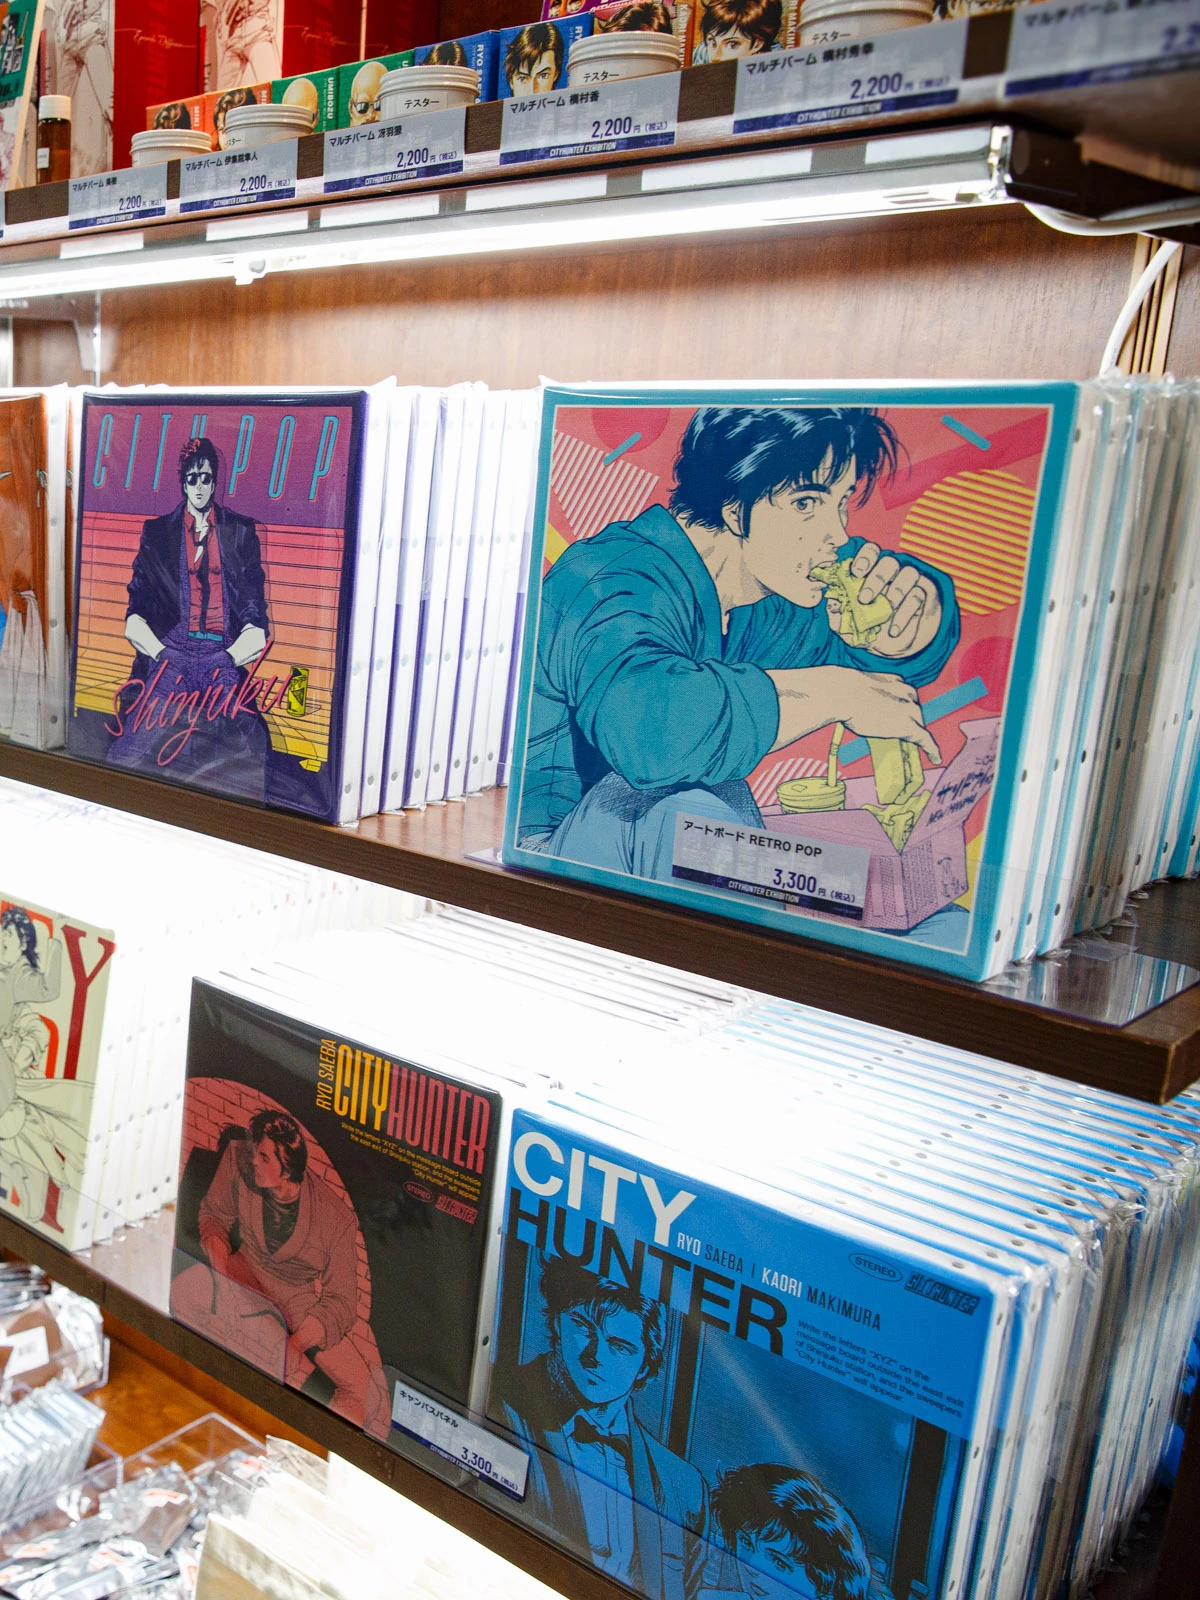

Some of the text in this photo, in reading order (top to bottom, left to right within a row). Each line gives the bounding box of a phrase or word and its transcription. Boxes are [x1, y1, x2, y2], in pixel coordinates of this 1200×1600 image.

[678, 3, 688, 32] KAORI
[786, 12, 796, 49] MAKIMU
[811, 31, 852, 43] テスター
[476, 44, 484, 66] RYO
[746, 53, 817, 75] マルチバーム
[583, 73, 619, 83] テスター
[326, 77, 335, 120] UMIBOZU
[404, 98, 440, 108] テスター
[509, 98, 566, 113] マルチバーム
[328, 131, 376, 148] マルチバーム
[185, 158, 222, 171] マルチバーム
[72, 180, 104, 192] マルチバーム
[228, 414, 340, 502] POP
[103, 639, 294, 767] Shinjuku
[683, 820, 823, 858] アートボード RETRO POP
[728, 880, 800, 904] CITYHUNTER EXHIBITION
[315, 1038, 337, 1111] RYO SAEBA
[512, 1131, 697, 1249] CITY
[508, 1187, 789, 1360] HUNTER
[677, 1232, 881, 1332] RYO SAEBA KAORI MAKIMURA
[855, 1256, 897, 1279] STEREO
[798, 1319, 820, 1335] Write
[822, 1330, 837, 1342] the
[838, 1336, 867, 1355] letters
[899, 1363, 912, 1373] on
[914, 1368, 930, 1382] the
[795, 1339, 805, 1348] of
[805, 1342, 843, 1367] Shinjuku
[879, 1375, 898, 1389] and
[899, 1383, 915, 1397] the
[916, 1391, 963, 1419] sweepers
[796, 1330, 965, 1409] message board outside the east exit
[852, 1375, 869, 1388] will
[399, 1390, 459, 1429] キャンバスパネル
